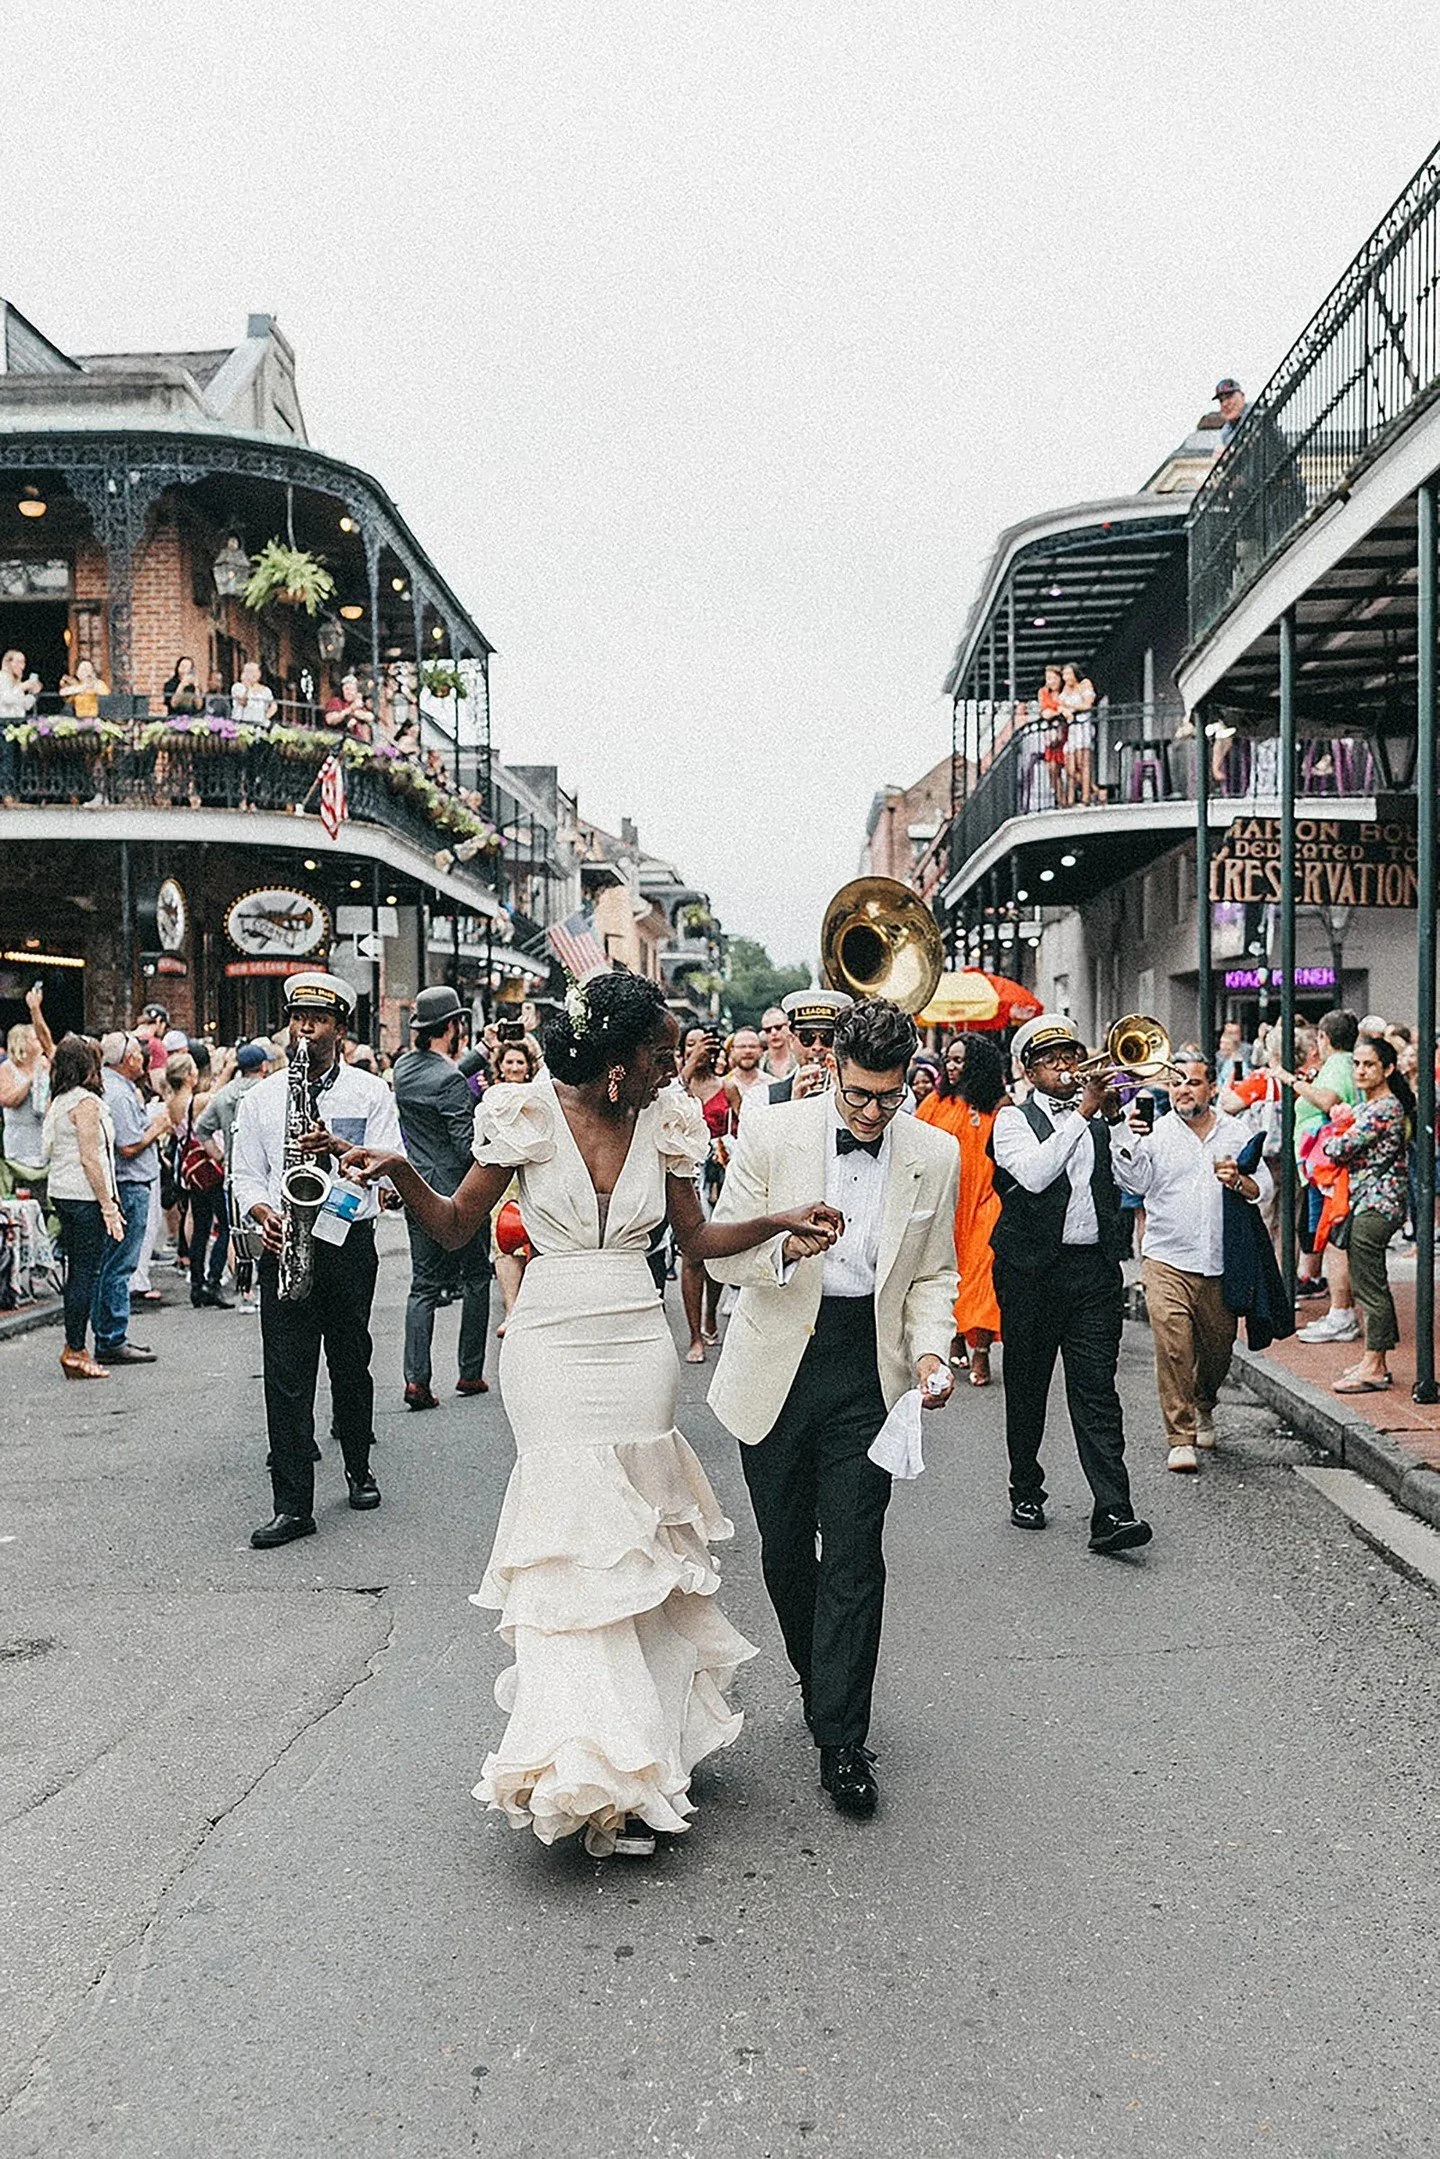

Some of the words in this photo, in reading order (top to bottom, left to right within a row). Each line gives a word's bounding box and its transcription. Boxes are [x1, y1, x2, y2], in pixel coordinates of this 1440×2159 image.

[1234, 842, 1364, 860] DEDATED
[1225, 969, 1265, 988] KRAZ
[1272, 966, 1335, 986] KRNER
[801, 1007, 832, 1016] LEADER
